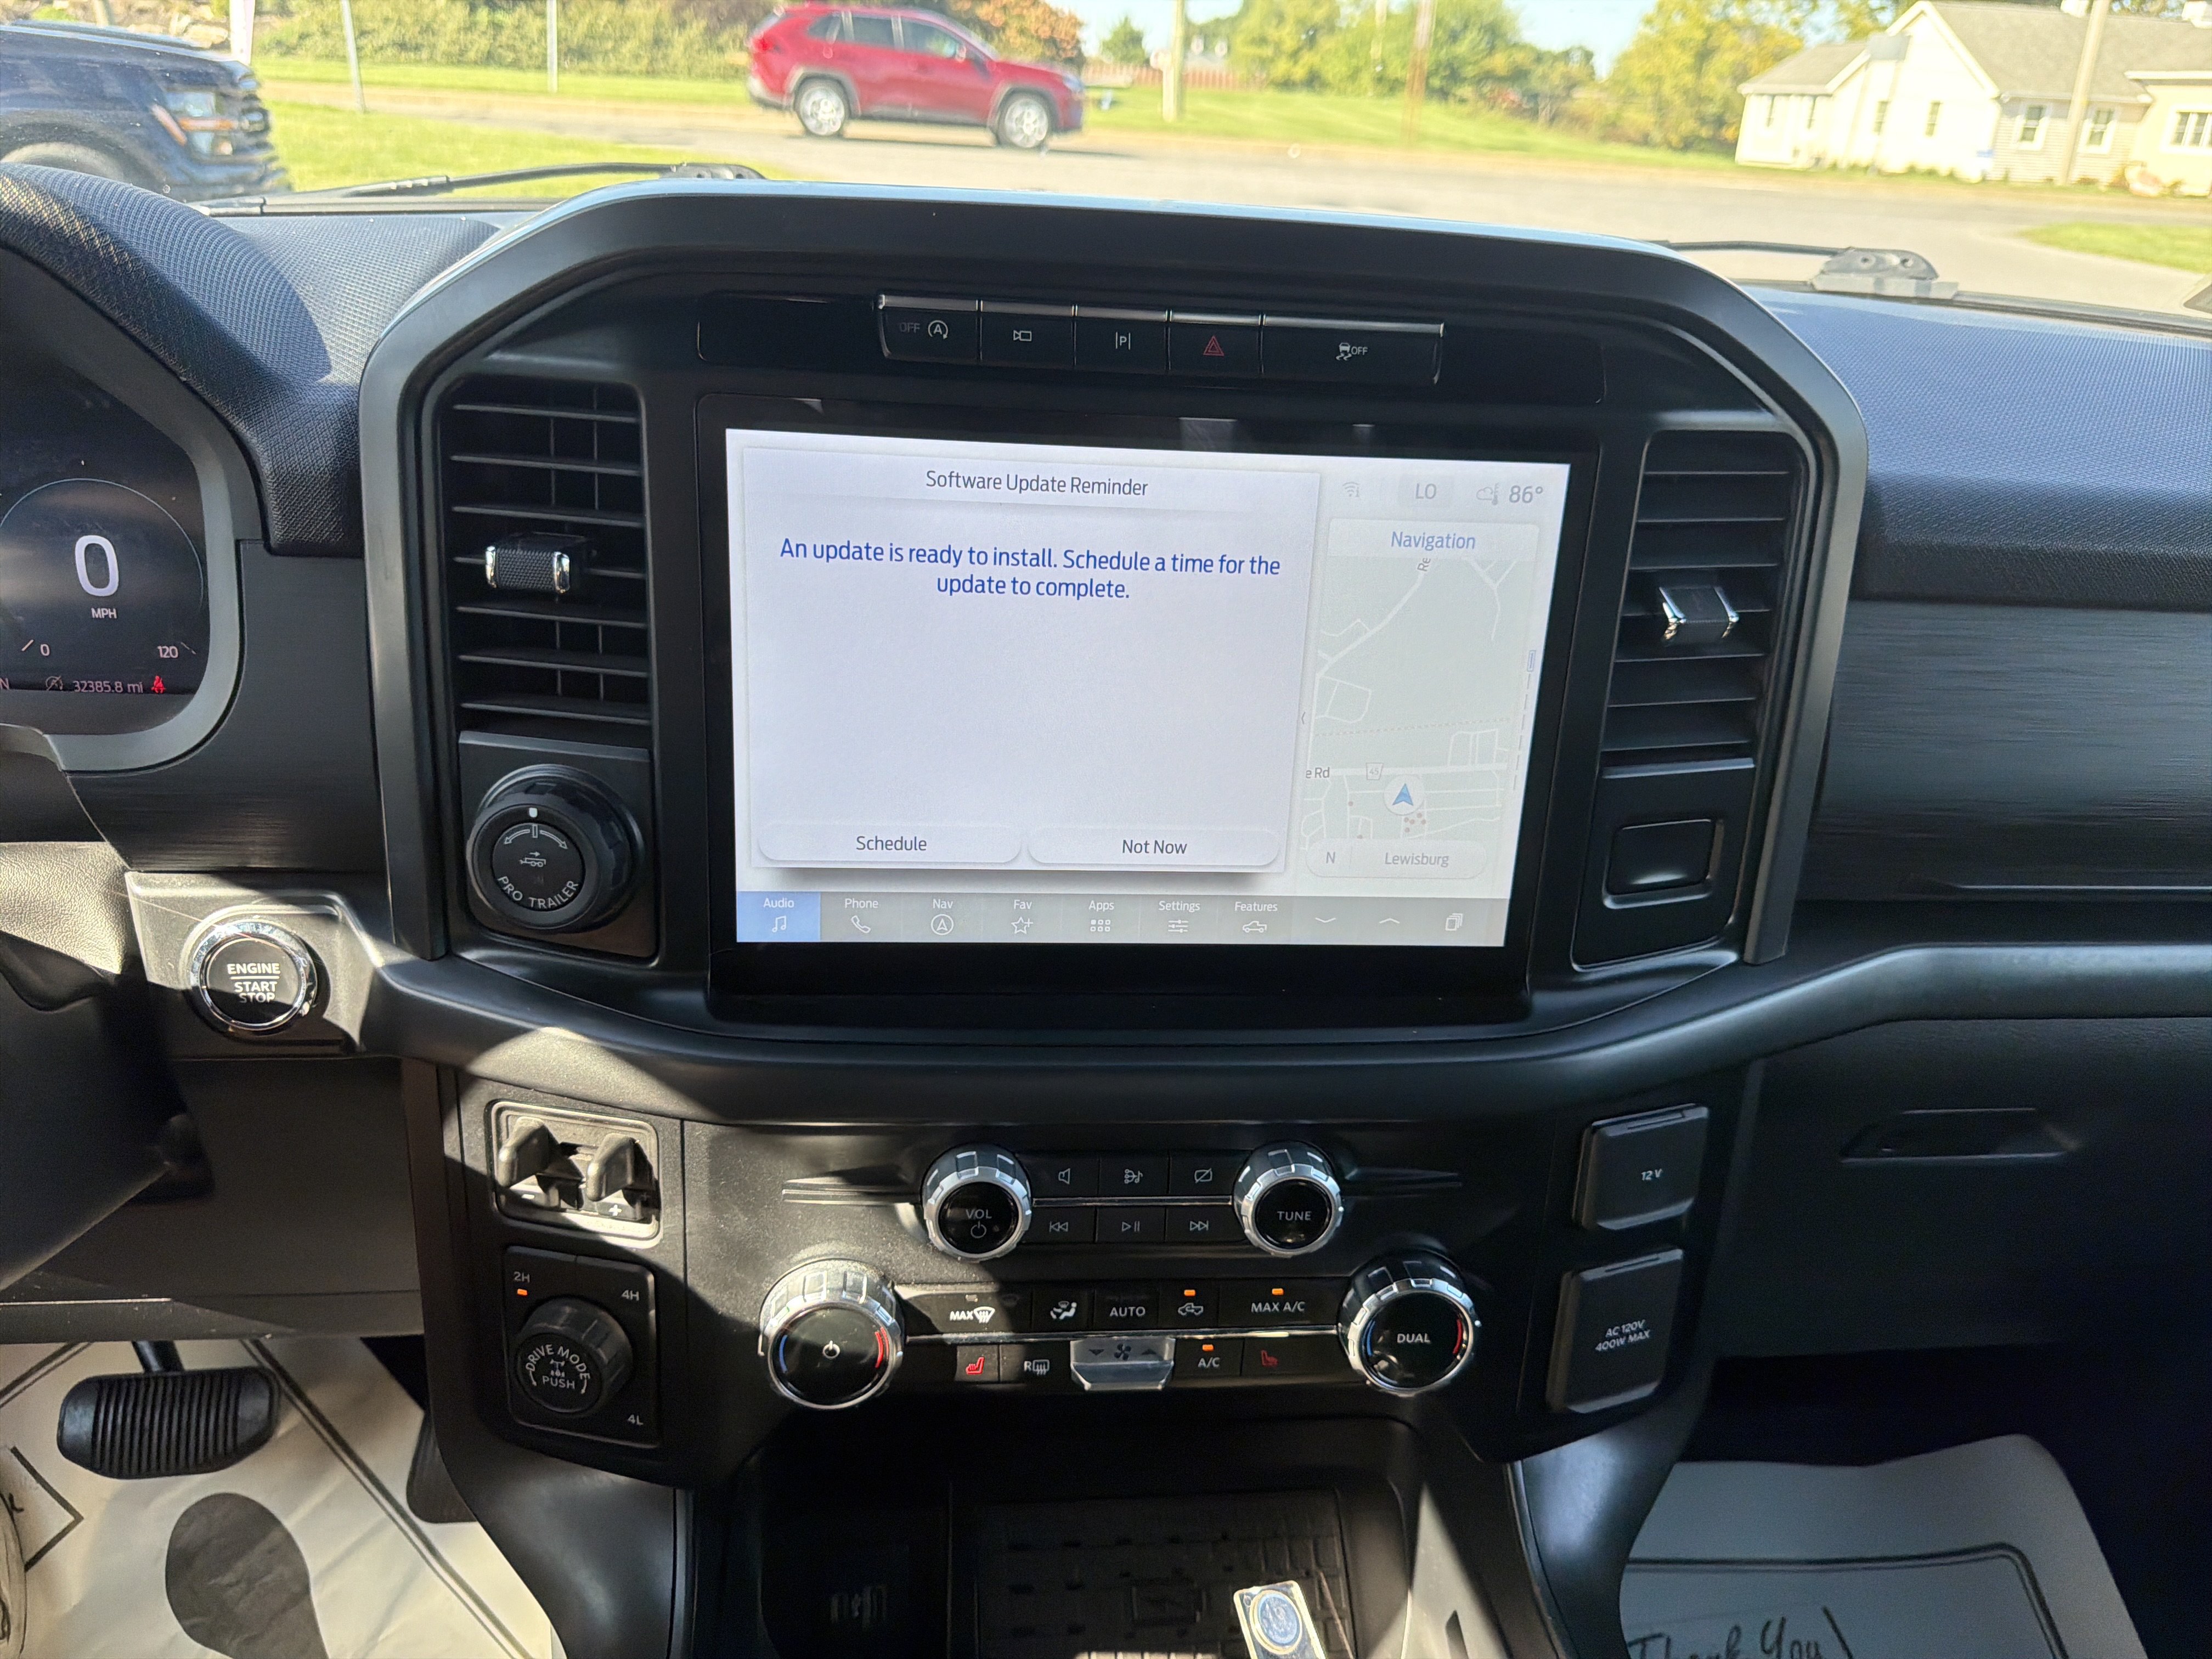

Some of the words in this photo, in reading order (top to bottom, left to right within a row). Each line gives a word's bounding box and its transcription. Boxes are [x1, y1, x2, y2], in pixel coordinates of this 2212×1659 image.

[899, 322, 921, 334] OFF
[1351, 346, 1368, 356] OFF
[926, 470, 1002, 490] Software
[1006, 473, 1067, 495] Update
[1070, 476, 1149, 496] Reminder
[1414, 482, 1437, 500] LO
[1508, 485, 1544, 504] 86°
[1390, 531, 1476, 552] Navigation
[780, 537, 808, 558] An
[812, 539, 884, 563] update
[889, 542, 905, 563] is
[909, 544, 963, 568] ready
[967, 546, 989, 566] to
[993, 546, 1058, 568] install.
[1062, 549, 1150, 572] Schedule
[1154, 556, 1166, 572] a
[1170, 552, 1214, 573] time
[1218, 554, 1246, 574] for
[1249, 555, 1280, 575] the
[75, 535, 119, 597] 0
[936, 573, 1007, 597] update
[1011, 576, 1031, 596] to
[1035, 577, 1130, 601] complete.
[91, 607, 117, 619] MPH
[40, 643, 50, 657] 0
[157, 645, 179, 659] 120
[72, 680, 123, 693] 32385.8
[127, 682, 143, 693] mi
[1314, 766, 1330, 779] Rd
[855, 834, 928, 852] Schedule
[1121, 838, 1150, 854] Not
[1153, 839, 1188, 855] Now
[1325, 851, 1336, 865] N
[1384, 851, 1450, 868] Lewisburg
[497, 876, 523, 901] PRO
[528, 880, 579, 909] TRAILER
[763, 897, 795, 909] Audio
[844, 897, 879, 909] Phone
[932, 898, 954, 910] Nav
[1013, 899, 1033, 910] Fav
[1088, 899, 1115, 913] Apps
[1158, 900, 1201, 913] Settings
[1234, 901, 1278, 912] Features
[226, 962, 281, 975] ENGINE
[234, 980, 278, 994] START
[238, 992, 276, 1004] STOP
[965, 1208, 992, 1220] VOL
[1276, 1210, 1312, 1222] TUNE
[514, 1271, 531, 1283] 2H
[621, 1289, 640, 1301] 4H
[1109, 1306, 1146, 1317] AUTO
[1251, 1302, 1280, 1313] MAX
[1283, 1300, 1305, 1313] A/C
[949, 1310, 974, 1321] MAX
[1605, 1327, 1621, 1338] AC
[1621, 1319, 1646, 1334] 120V
[1396, 1333, 1431, 1344] DUAL
[1595, 1336, 1627, 1352] 400W
[1628, 1329, 1651, 1344] MAX
[525, 1344, 554, 1372] DRIVE
[557, 1346, 591, 1380] MODE
[1197, 1357, 1221, 1369] A/C
[542, 1375, 575, 1390] PUSH
[627, 1414, 644, 1426] 4L
